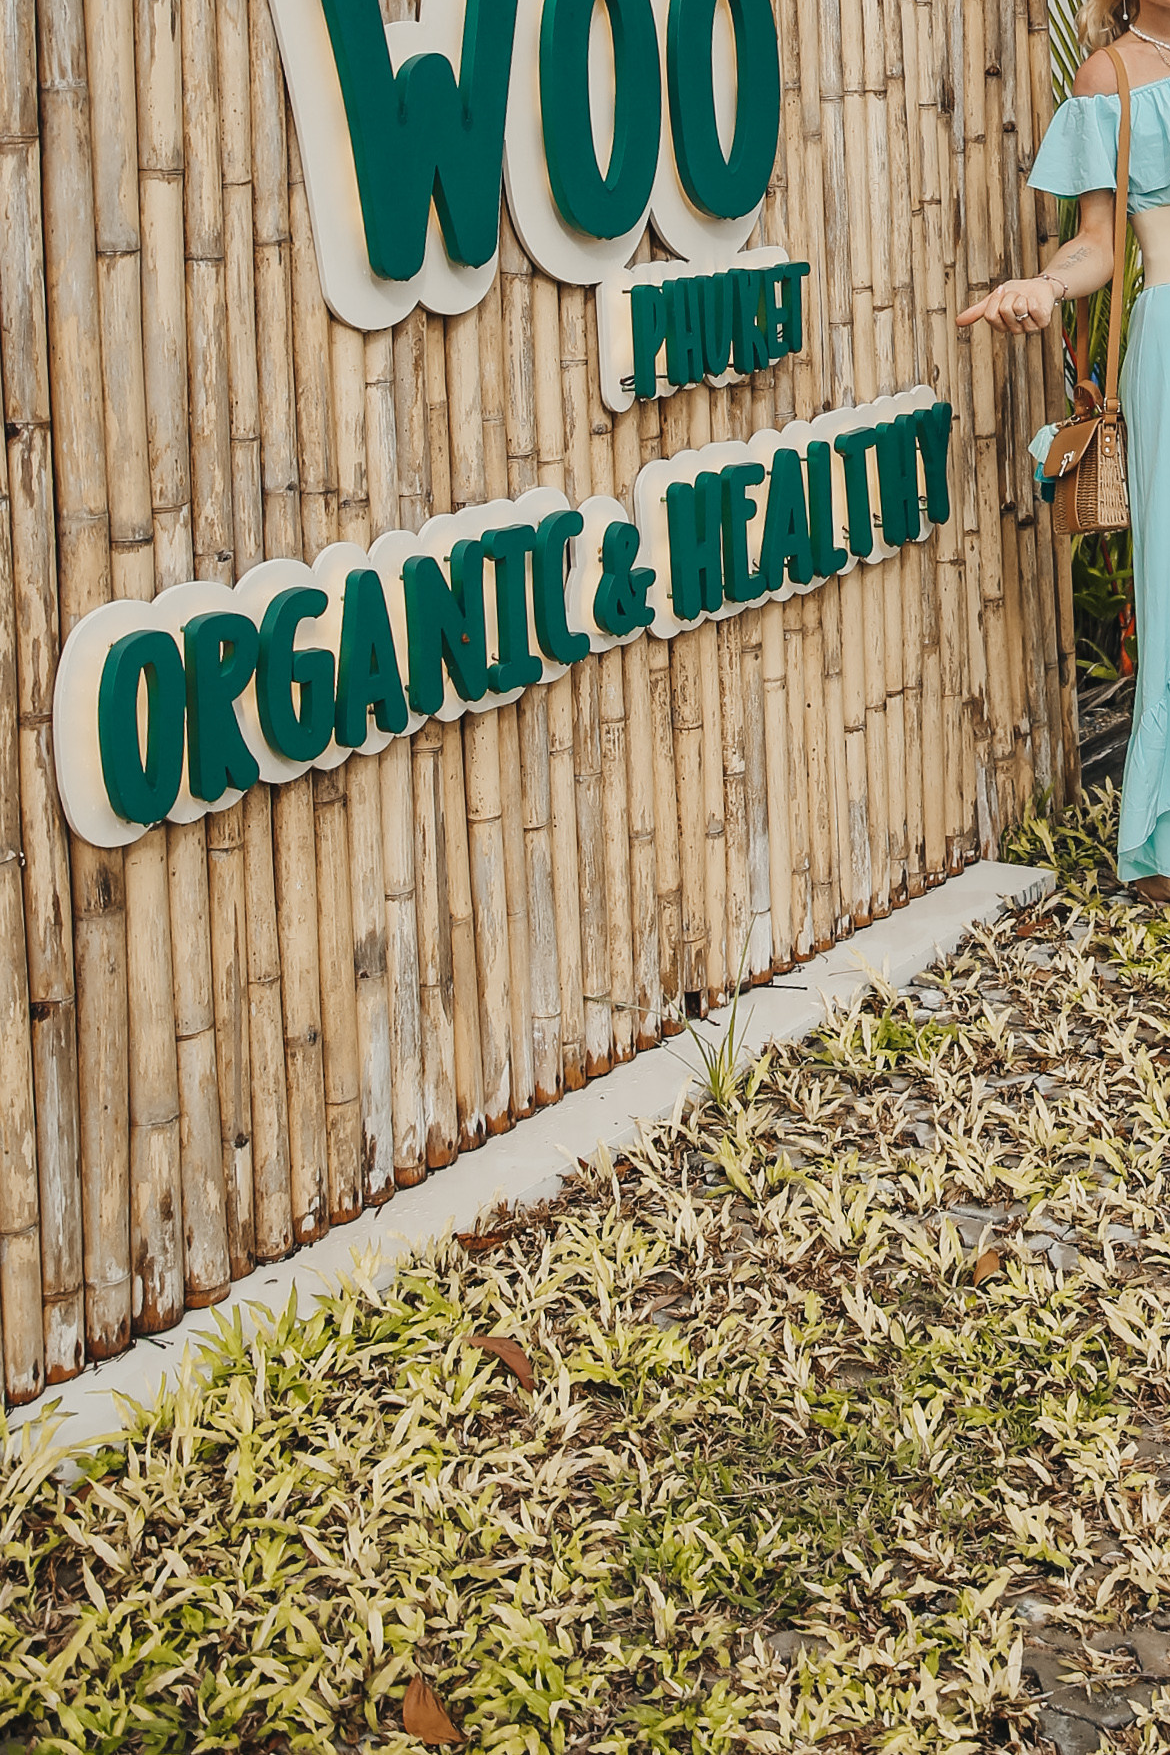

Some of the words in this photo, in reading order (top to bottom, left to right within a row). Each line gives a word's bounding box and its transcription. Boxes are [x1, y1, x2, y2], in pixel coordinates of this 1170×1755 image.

[630, 262, 810, 399] PHUKET
[97, 509, 591, 826] ORGANIC
[593, 521, 656, 636] &
[666, 401, 952, 621] HEALTHY
